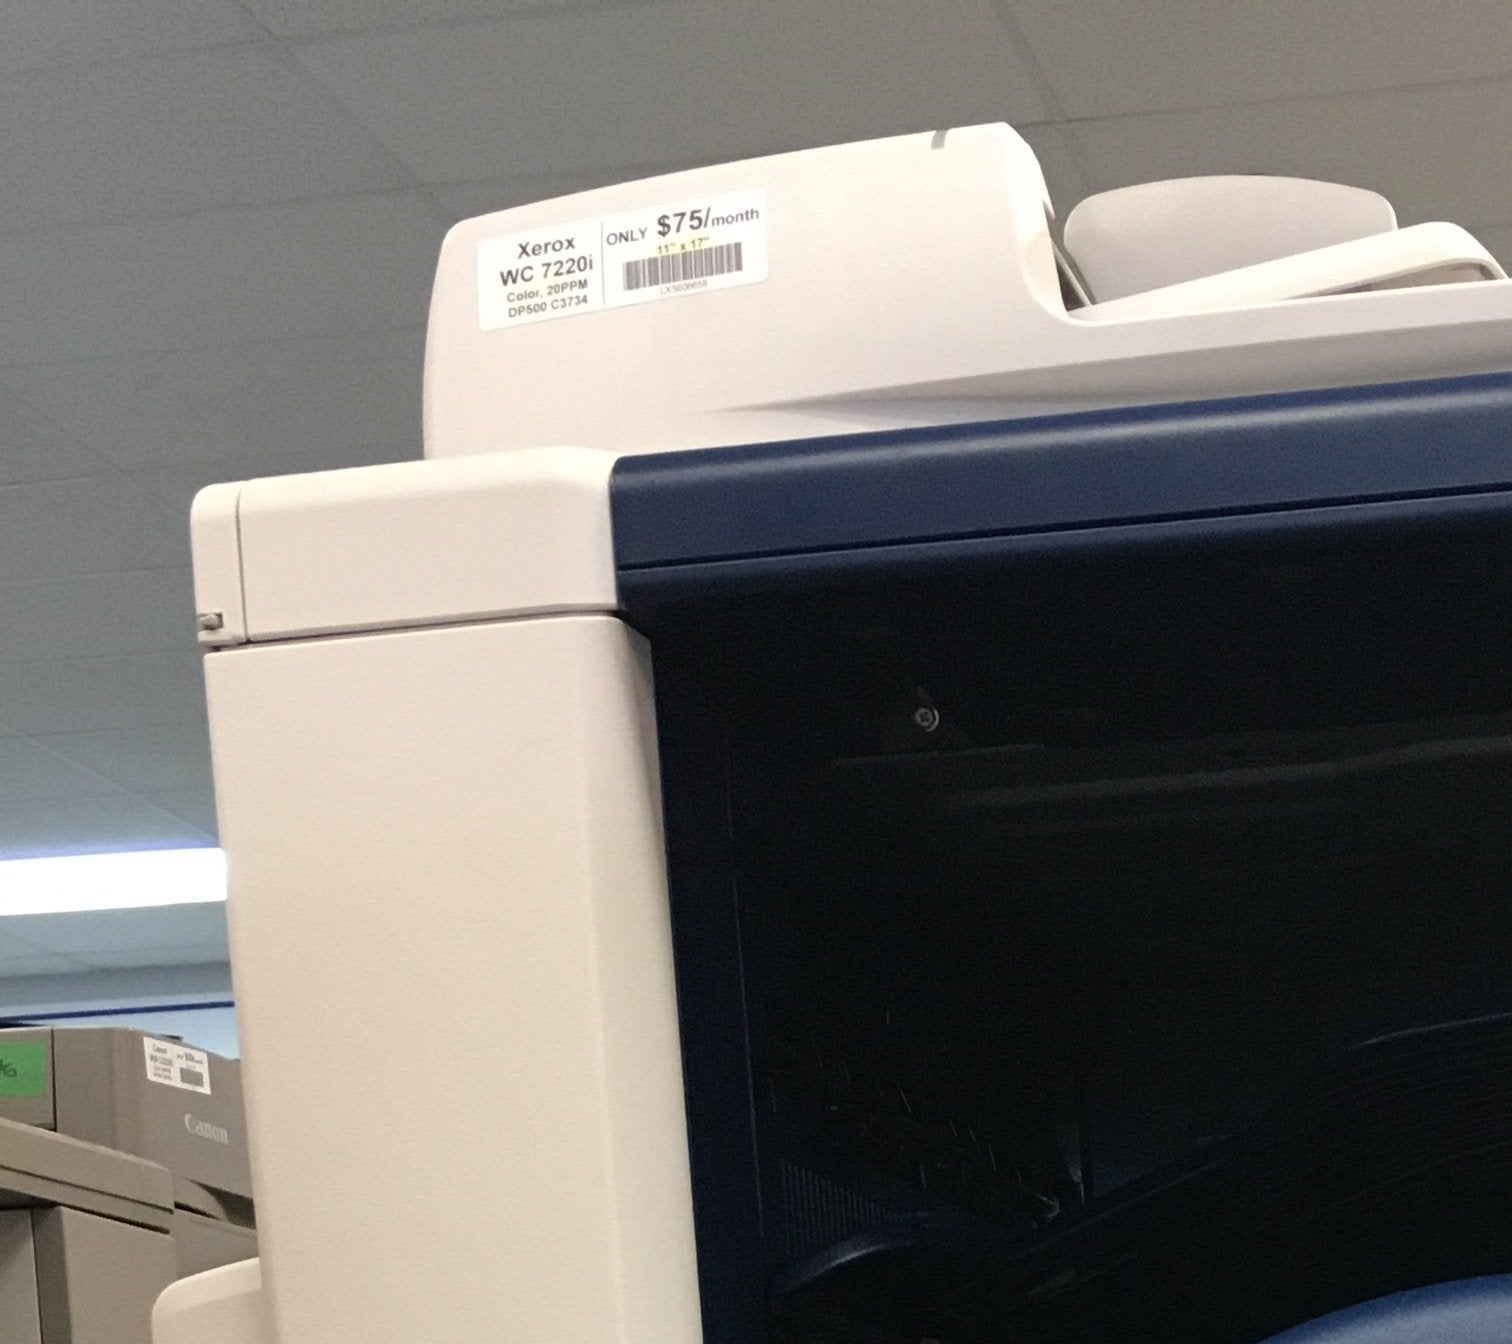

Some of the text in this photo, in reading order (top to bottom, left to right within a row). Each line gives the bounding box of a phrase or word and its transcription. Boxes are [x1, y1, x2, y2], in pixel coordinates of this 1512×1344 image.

[606, 207, 760, 246] ONLY $75/month
[517, 237, 576, 260] Xerox
[500, 254, 594, 286] WC 7220i
[546, 278, 588, 296] 20PPM
[508, 294, 588, 318] DP500 C3734
[184, 1113, 229, 1146] Canon
